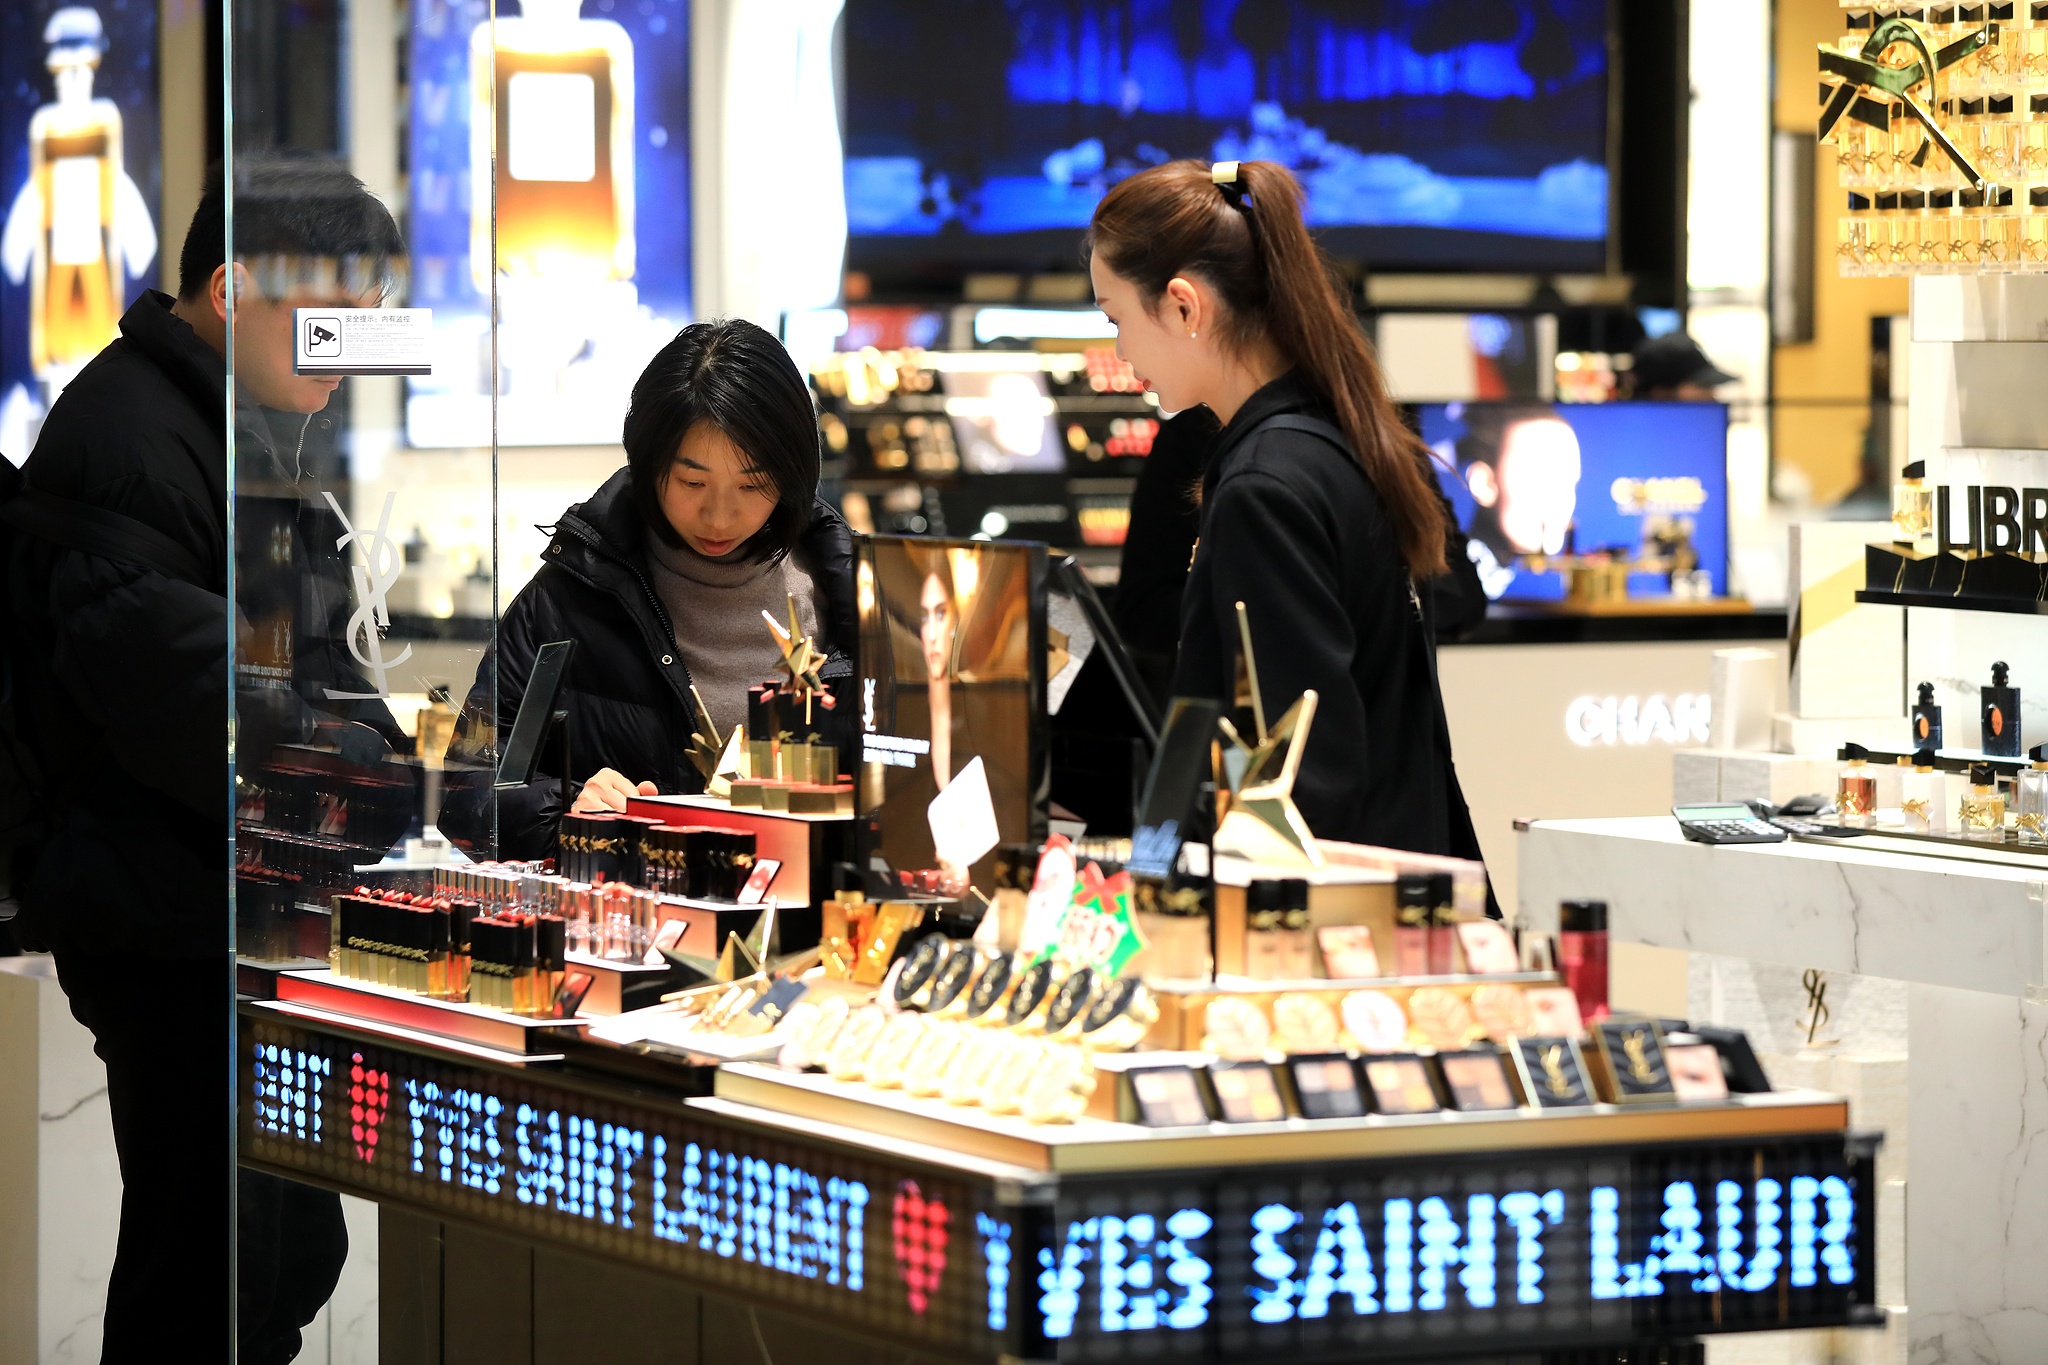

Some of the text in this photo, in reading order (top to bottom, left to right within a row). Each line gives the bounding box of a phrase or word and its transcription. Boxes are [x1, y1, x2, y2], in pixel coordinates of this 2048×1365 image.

[1937, 485, 2048, 561] LIBR
[653, 1134, 869, 1291] LAURENT
[1249, 1189, 1564, 1323] SAINT
[1590, 1175, 1853, 1299] LAUR
